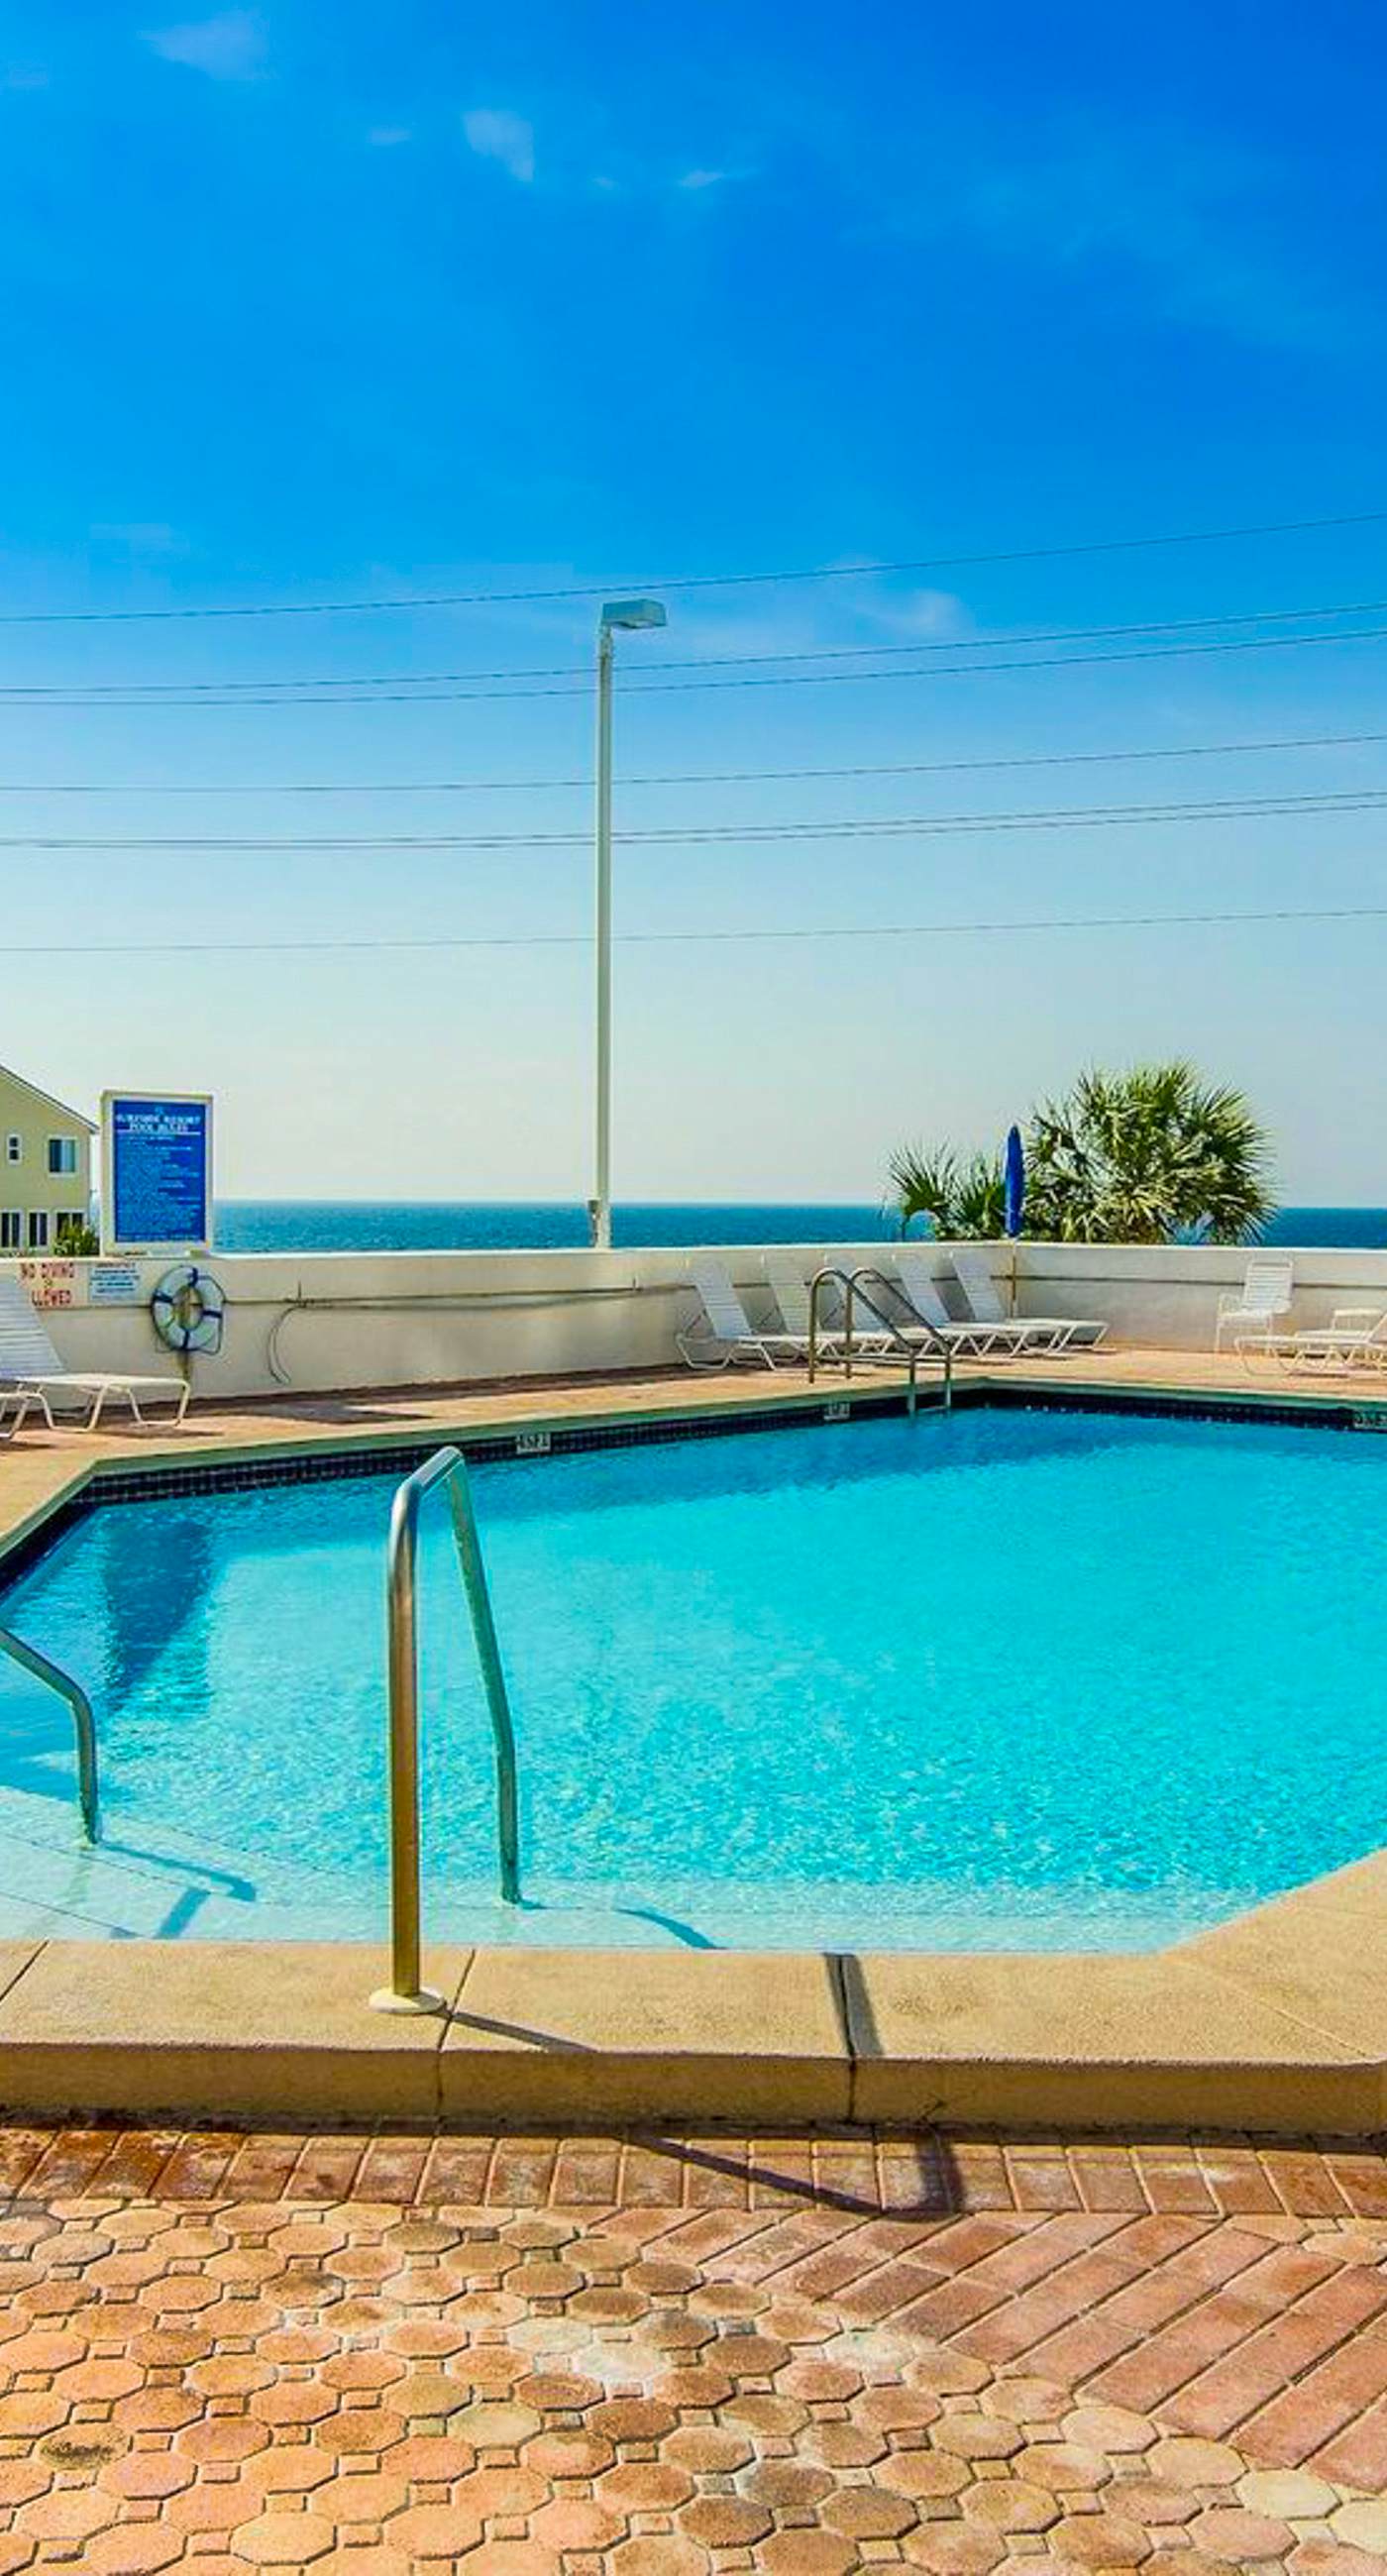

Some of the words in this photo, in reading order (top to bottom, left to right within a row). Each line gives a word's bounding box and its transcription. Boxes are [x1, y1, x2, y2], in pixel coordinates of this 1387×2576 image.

[20, 1262, 36, 1279] NO
[41, 1261, 75, 1279] DIVING
[31, 1290, 72, 1307] LLOWED
